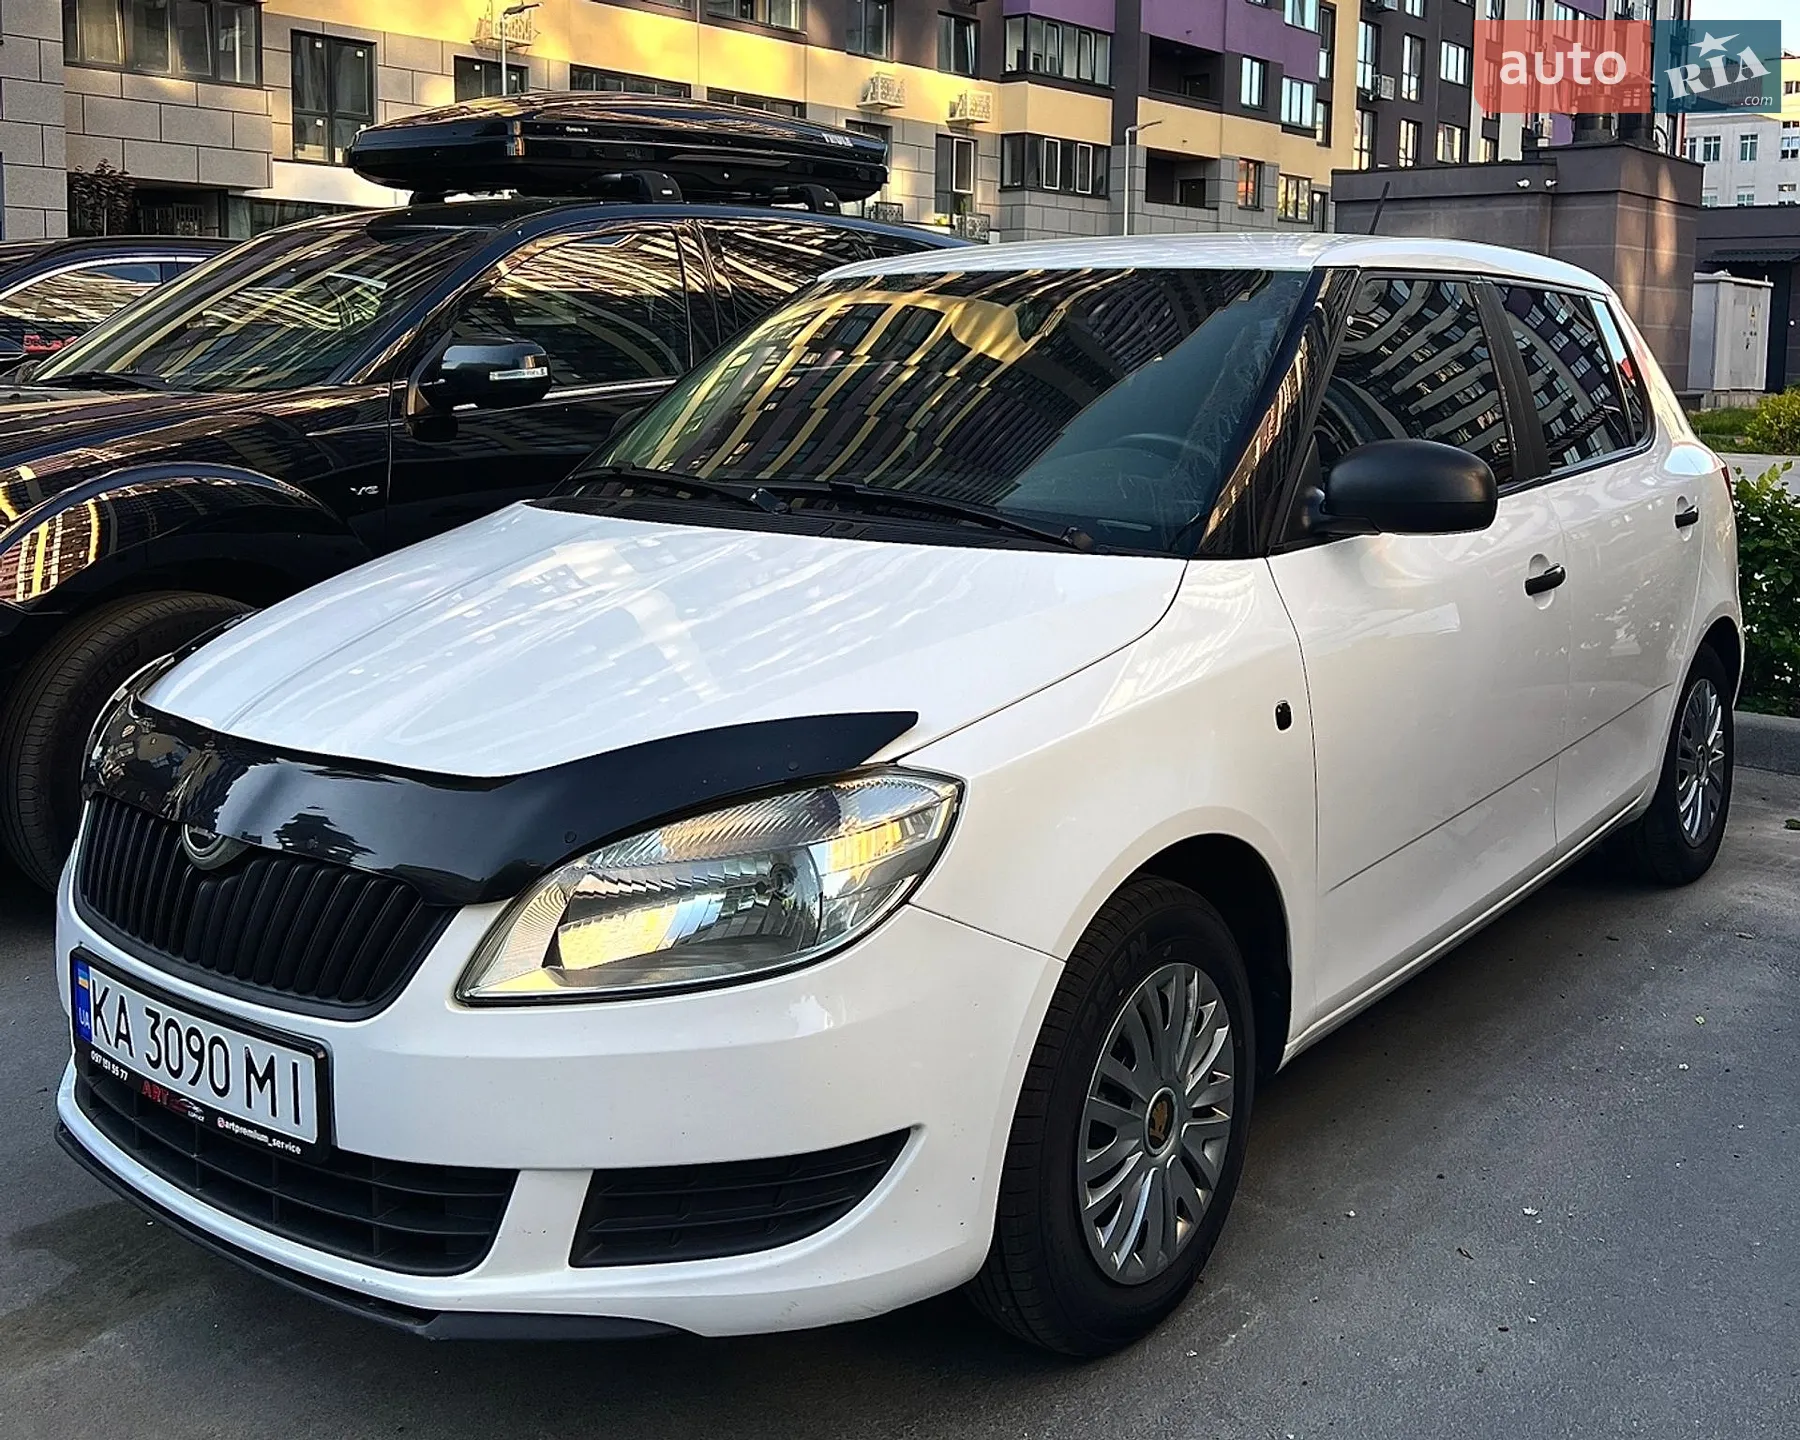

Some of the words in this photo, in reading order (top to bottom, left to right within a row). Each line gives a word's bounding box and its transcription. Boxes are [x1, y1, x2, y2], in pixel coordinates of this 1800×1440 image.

[78, 1006, 91, 1030] UA
[92, 978, 135, 1059] KA
[145, 1006, 231, 1098] 3090
[245, 1046, 300, 1126] MI
